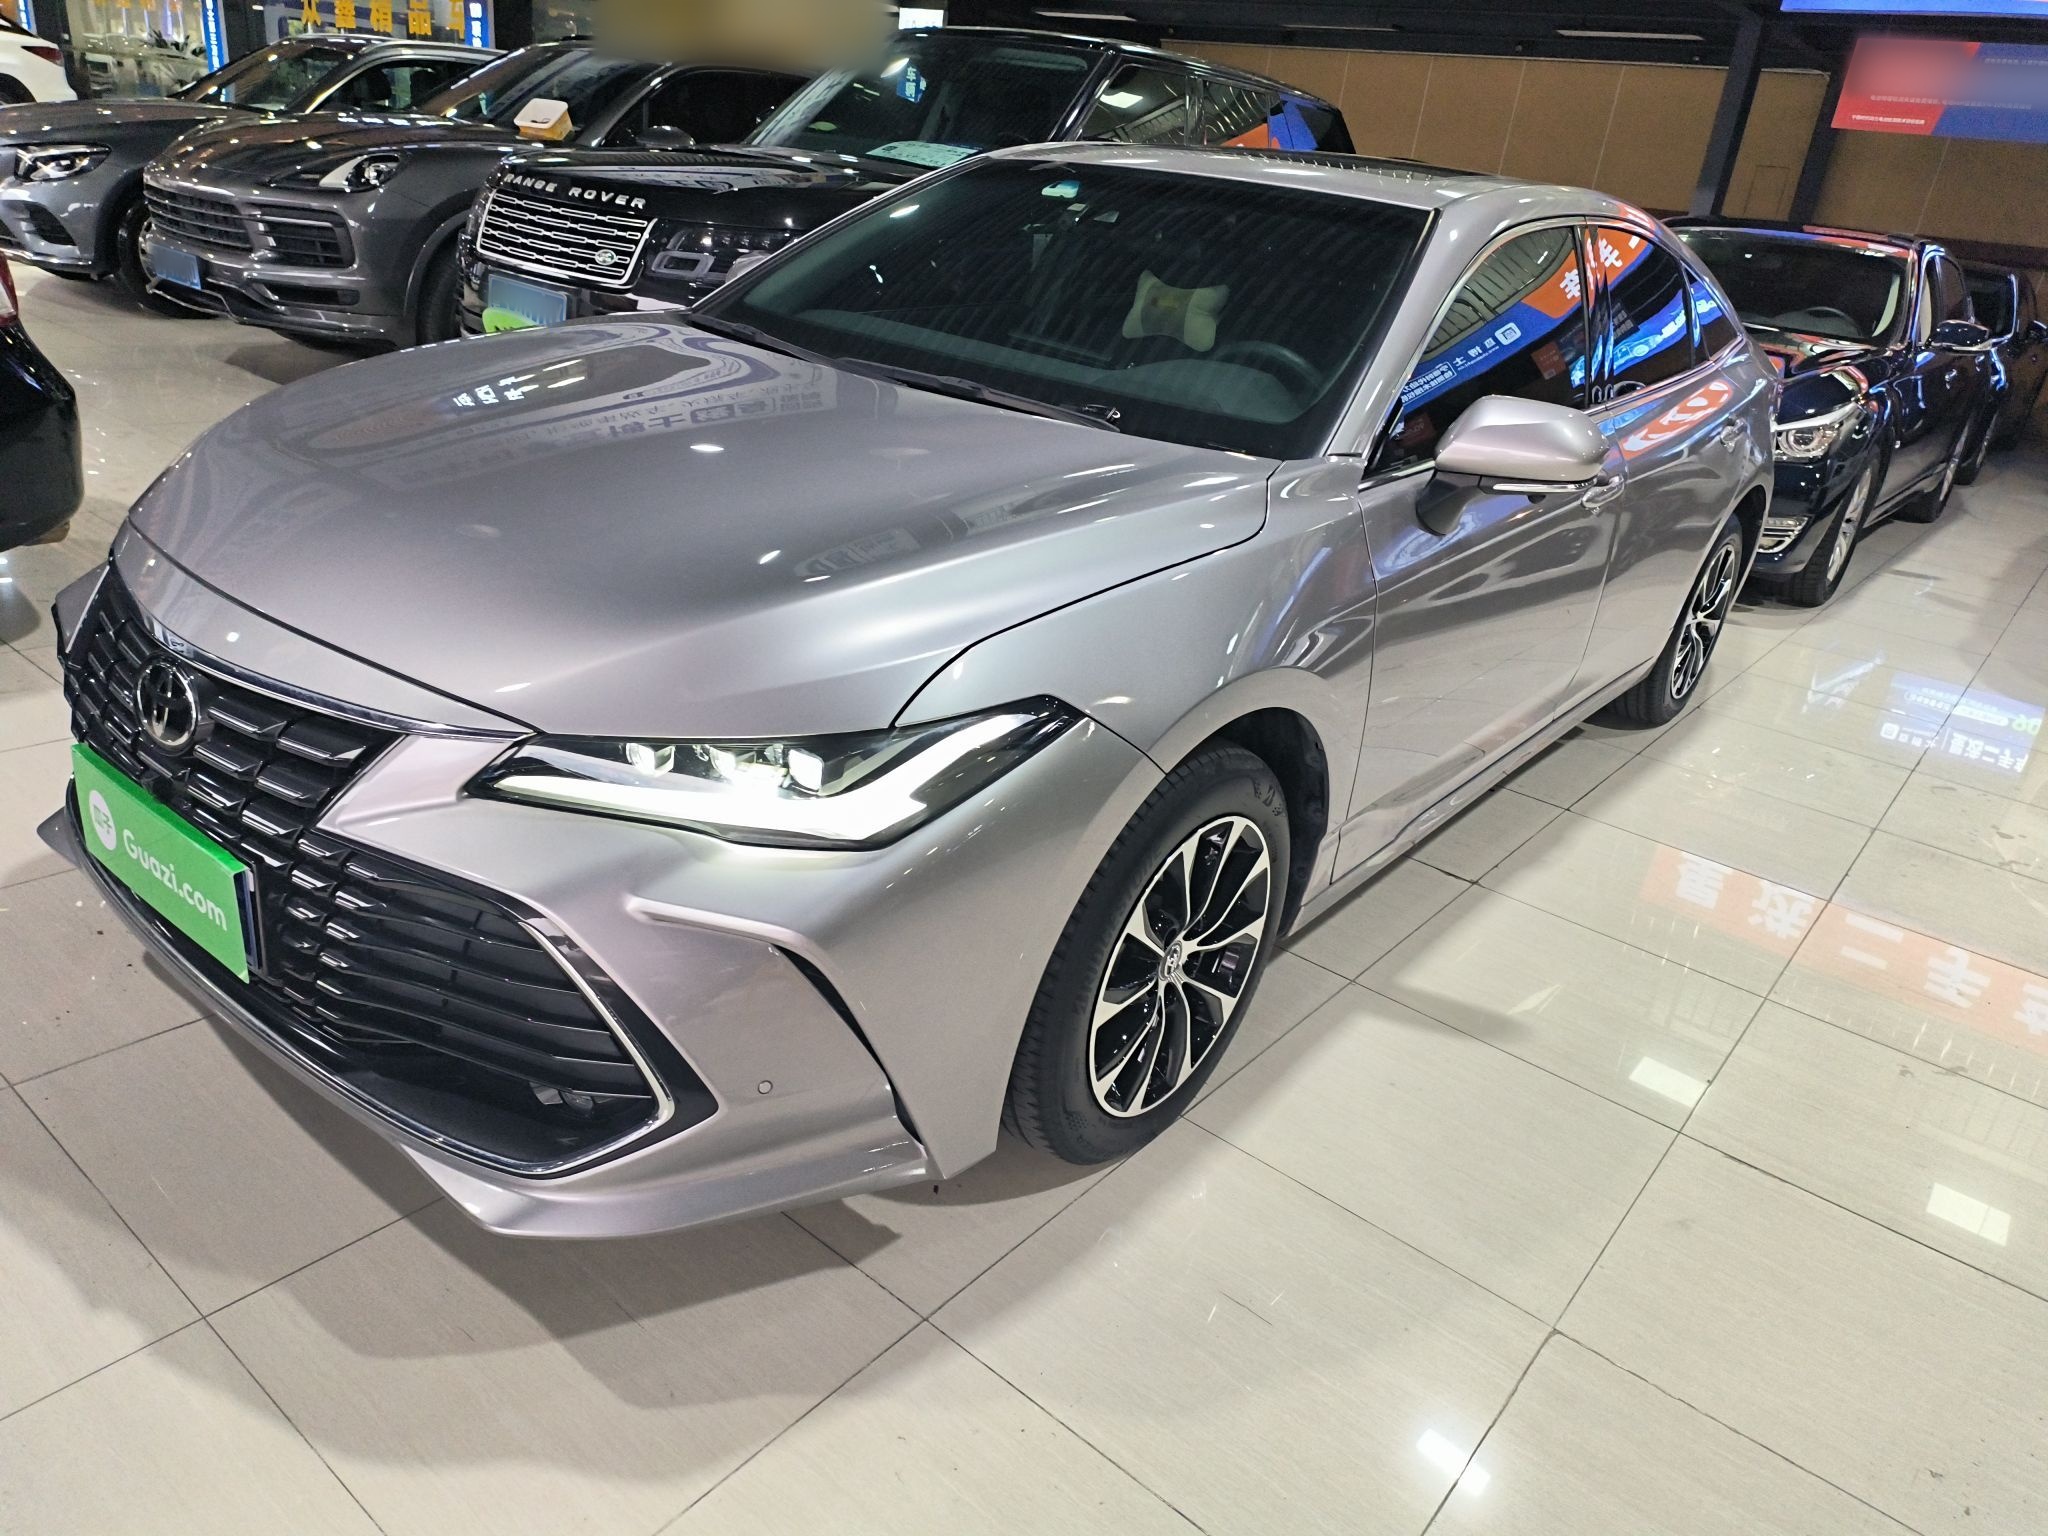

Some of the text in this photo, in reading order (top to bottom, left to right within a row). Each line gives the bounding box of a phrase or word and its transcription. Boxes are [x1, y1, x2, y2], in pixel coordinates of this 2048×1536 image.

[503, 172, 647, 210] RANGE ROVER
[122, 829, 228, 931] Guazi.com
